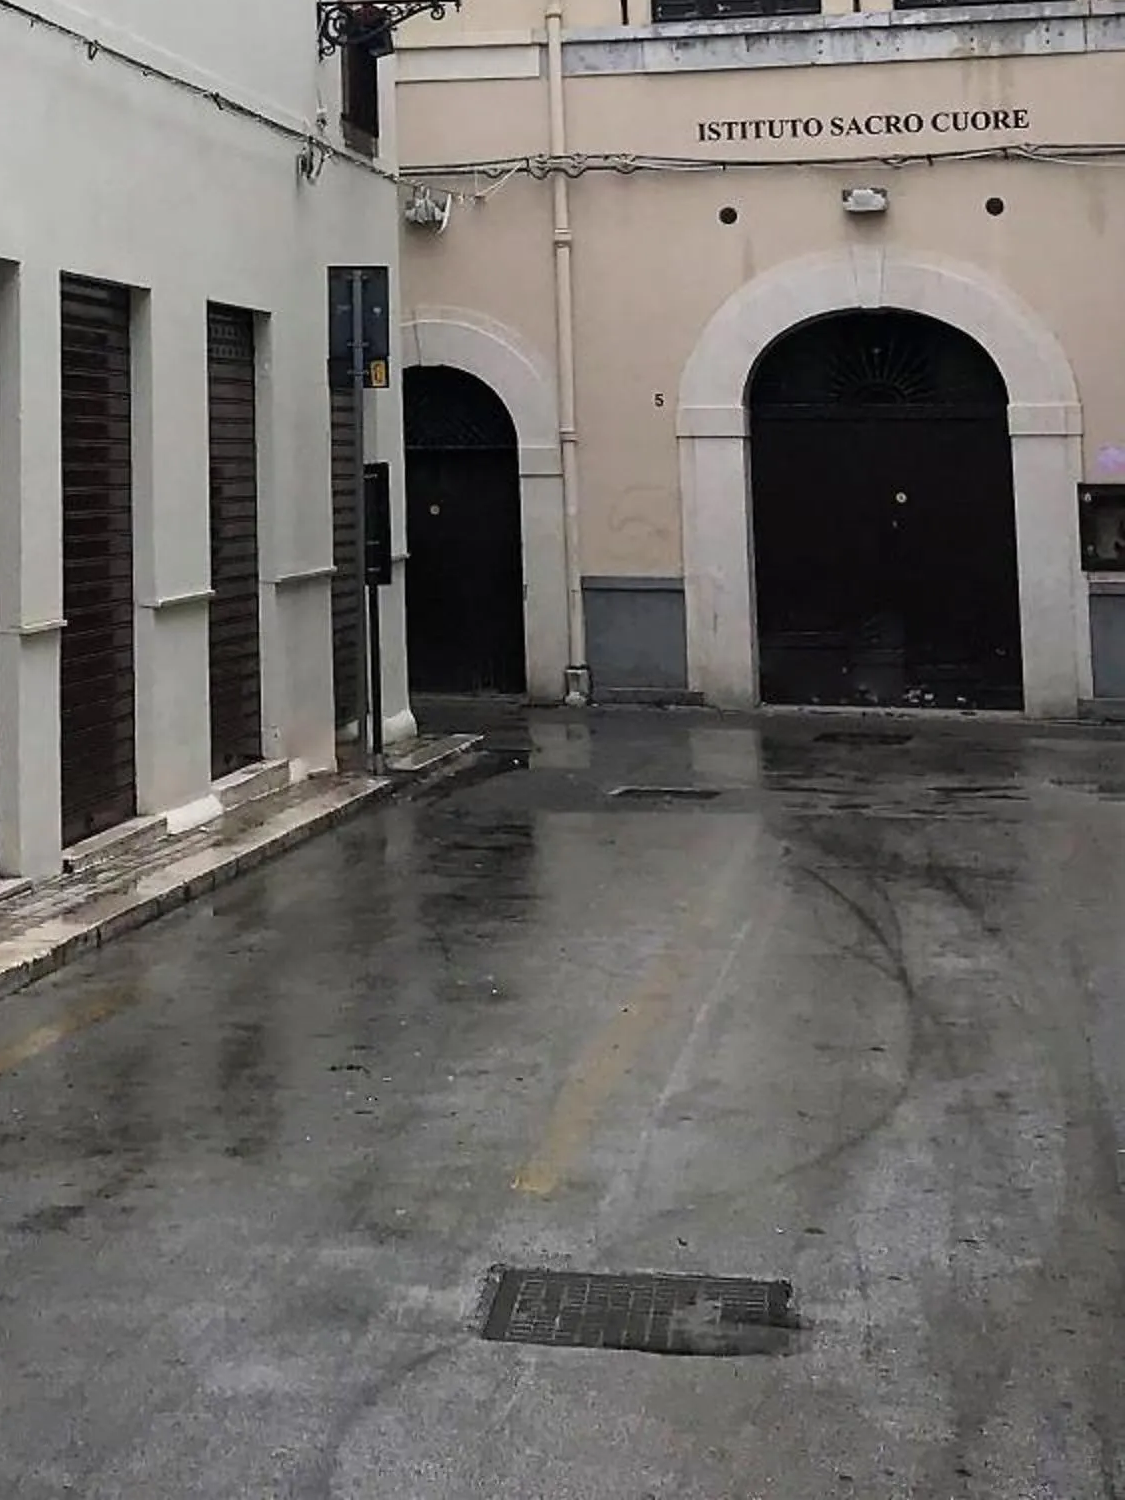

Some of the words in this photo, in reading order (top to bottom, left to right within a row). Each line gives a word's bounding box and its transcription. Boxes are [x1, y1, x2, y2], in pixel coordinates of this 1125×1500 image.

[698, 117, 824, 142] ISTITUTO
[830, 113, 924, 137] SACRO
[930, 109, 1030, 133] CUORE
[654, 392, 664, 407] 5
